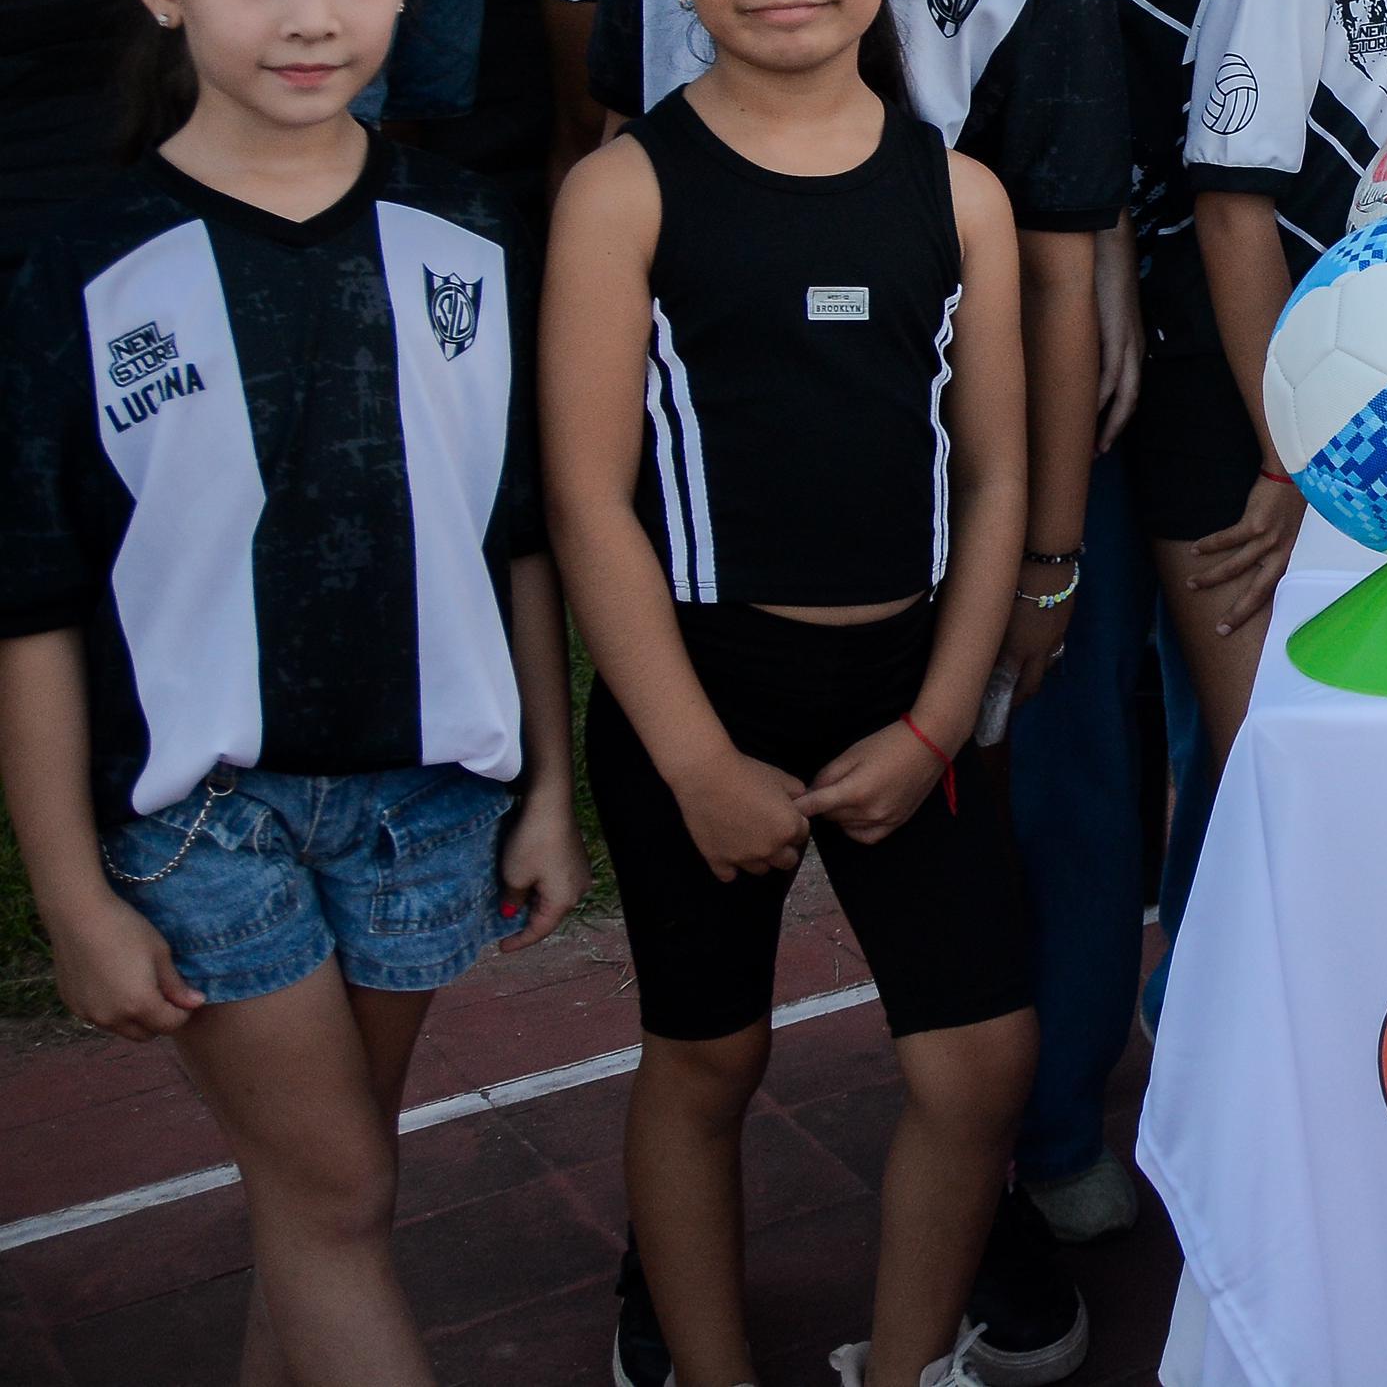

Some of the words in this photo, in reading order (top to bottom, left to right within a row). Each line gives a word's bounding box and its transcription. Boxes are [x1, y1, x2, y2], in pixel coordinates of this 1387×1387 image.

[816, 305, 861, 313] BROOKLYN
[113, 328, 158, 361] NEW
[114, 340, 176, 384] STORE
